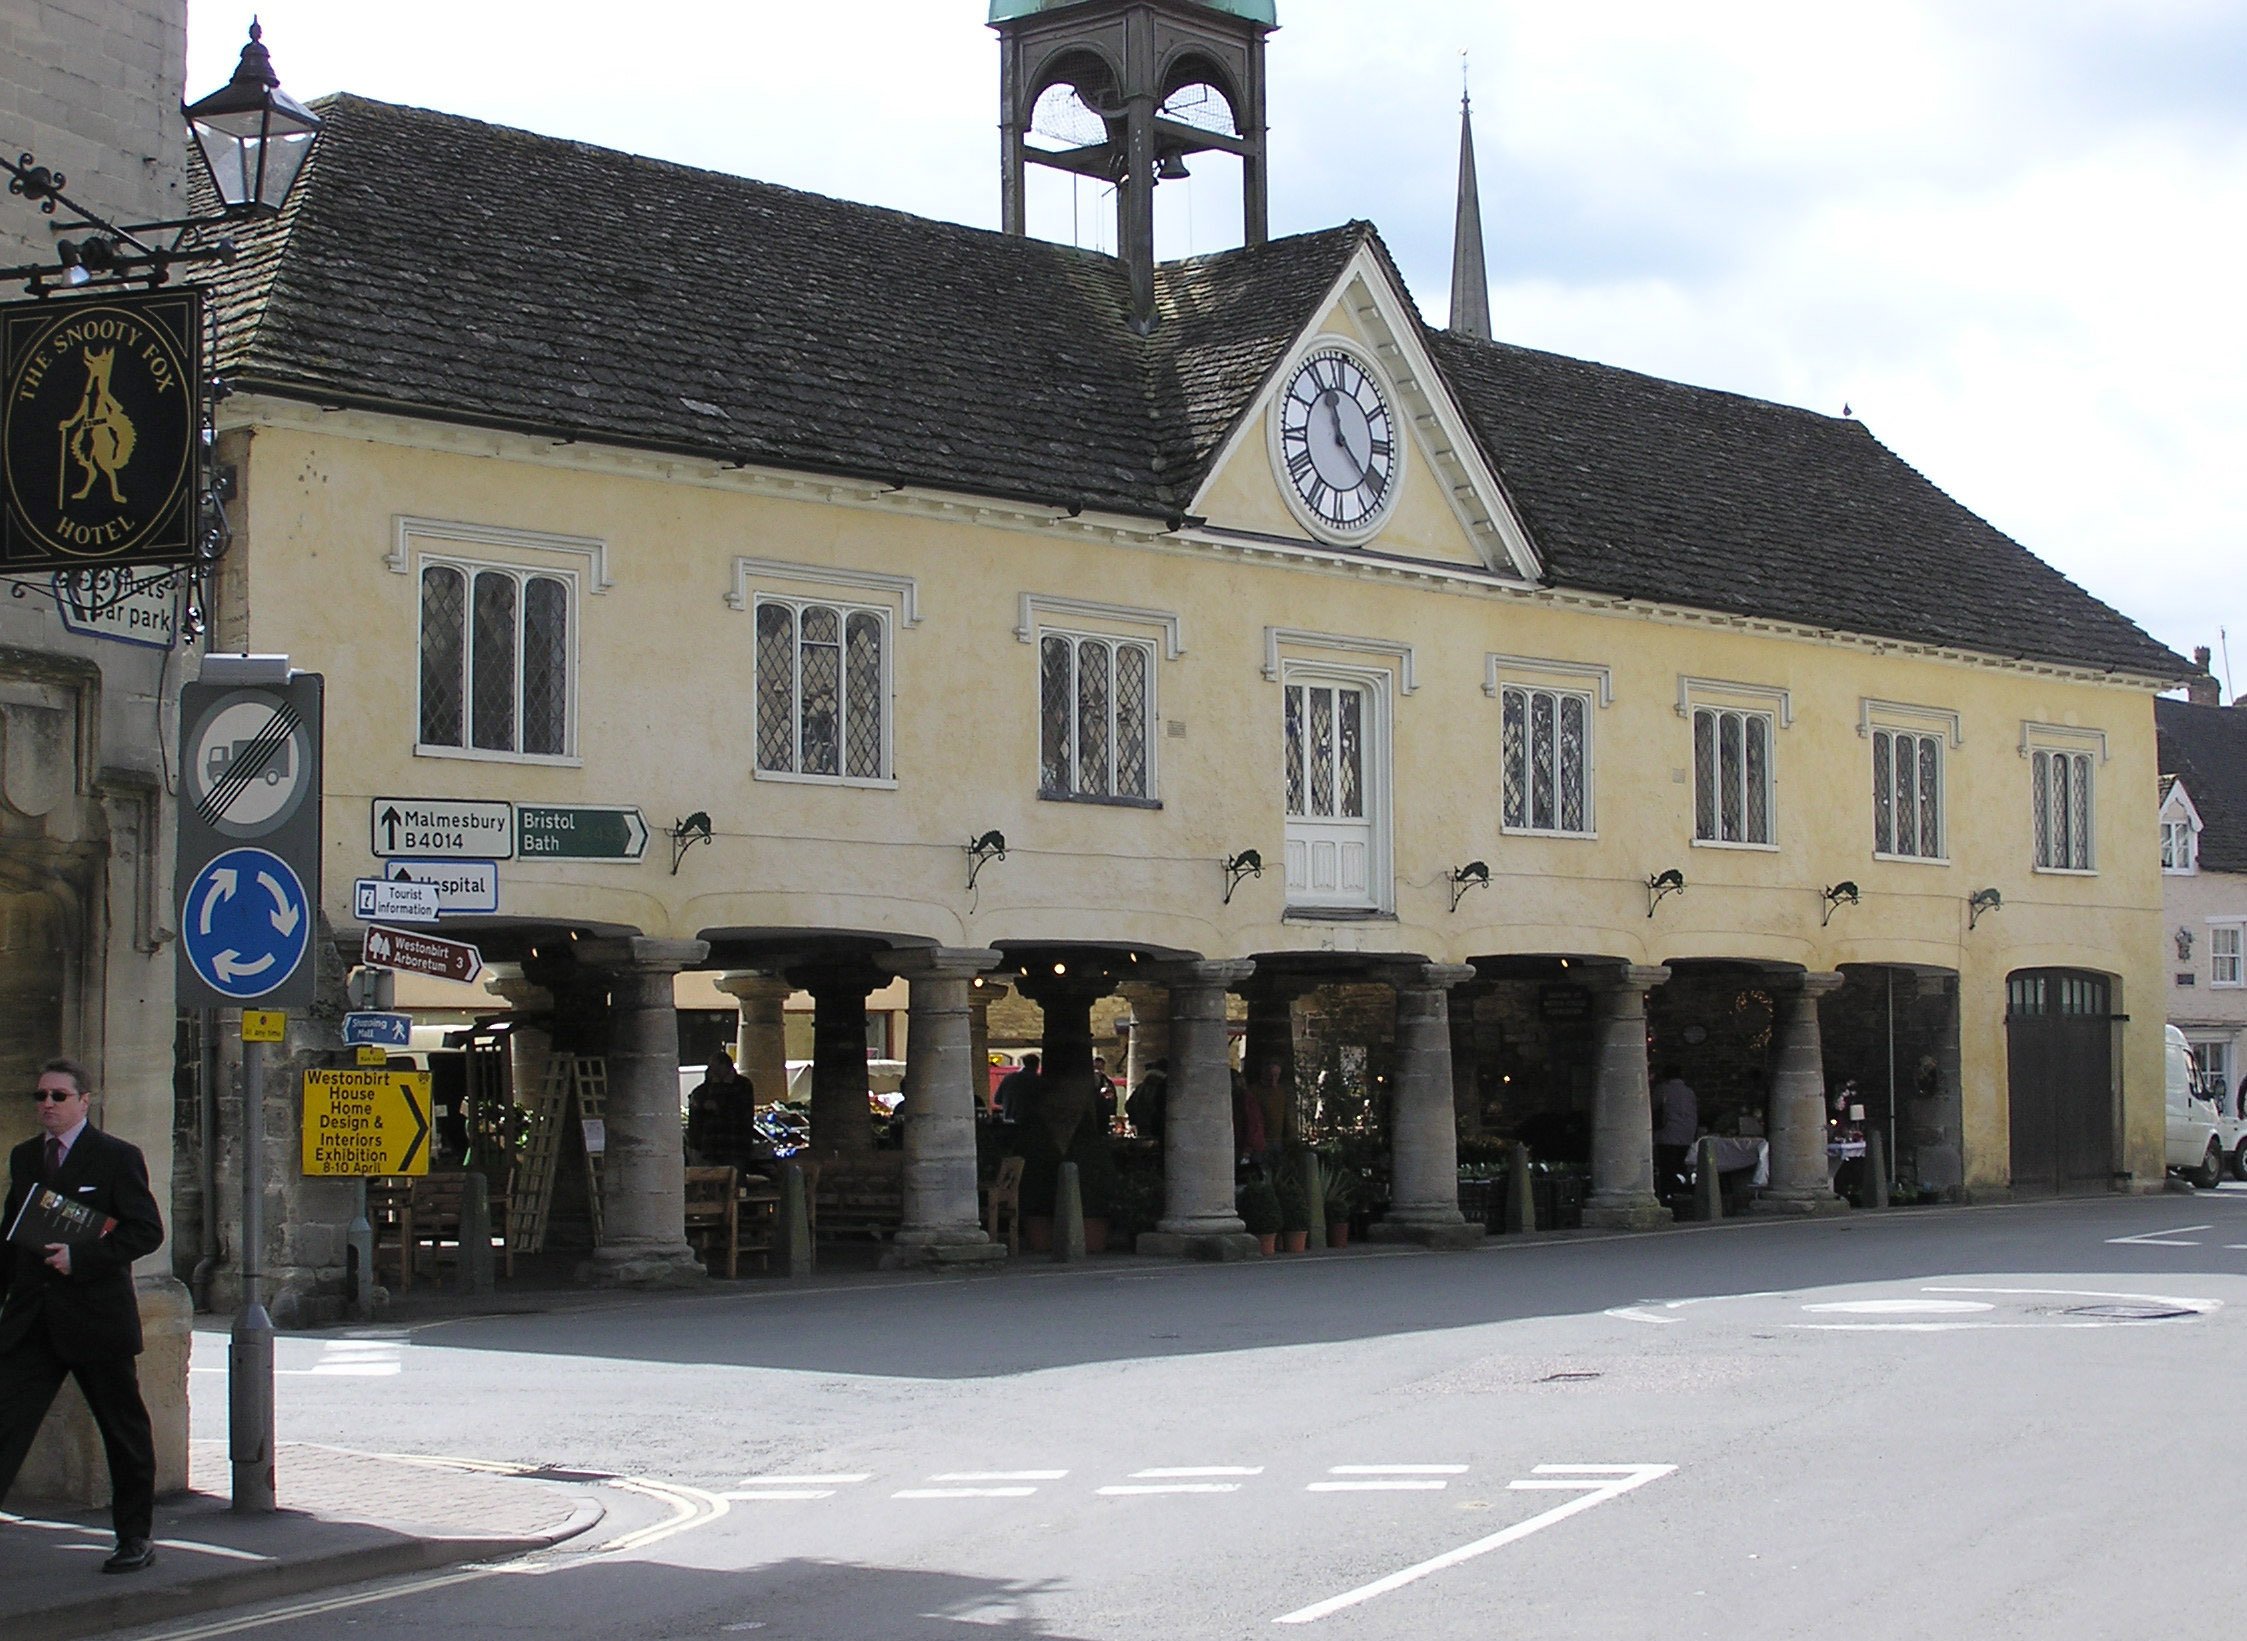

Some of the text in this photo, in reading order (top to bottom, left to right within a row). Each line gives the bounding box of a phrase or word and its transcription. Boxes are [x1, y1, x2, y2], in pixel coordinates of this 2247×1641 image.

[19, 319, 175, 401] THE SNOOTY FOX
[56, 516, 135, 545] HOTEL
[130, 607, 170, 632] park
[405, 811, 506, 832] Malmesbury
[524, 811, 575, 830] Bristol
[405, 832, 463, 849] B4014
[524, 834, 559, 851] Bath
[389, 887, 422, 900] Tourist
[420, 876, 485, 895] spital
[394, 936, 449, 958] Westonbirt
[394, 951, 464, 972] Arboretum 3
[308, 1071, 390, 1086] Westonbirt
[330, 1087, 375, 1100] House
[331, 1101, 372, 1115] Home
[320, 1115, 383, 1131] Design &
[321, 1133, 382, 1146] Interiors
[316, 1147, 387, 1162] Exhibition
[323, 1161, 381, 1174] 8-10 April
